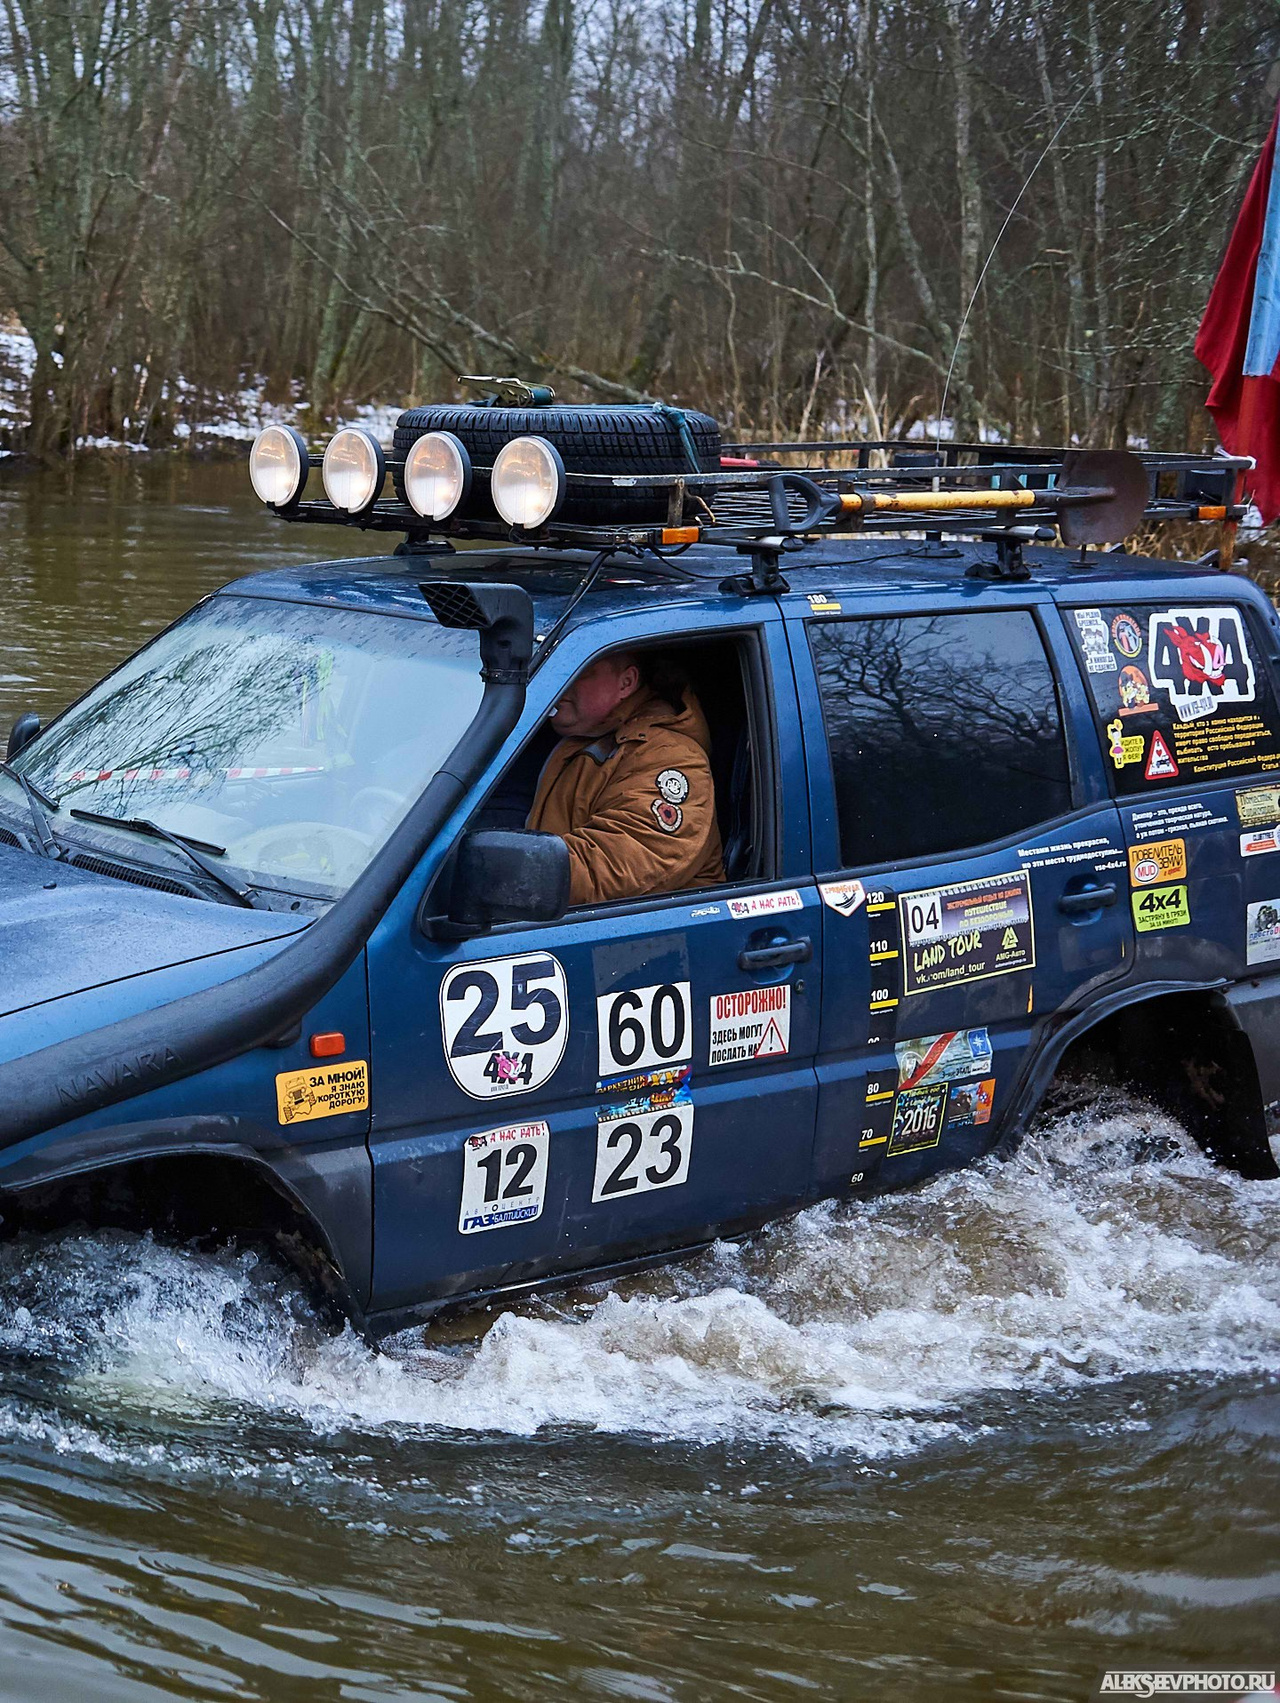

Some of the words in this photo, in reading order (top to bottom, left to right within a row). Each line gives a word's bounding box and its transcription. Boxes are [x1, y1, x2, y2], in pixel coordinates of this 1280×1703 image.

[807, 594, 827, 604] 180
[1018, 846, 1050, 857] Местами
[1073, 838, 1110, 849] прекрасна,
[1132, 844, 1183, 862] ПОВЕЛИТЕЛЬ
[1032, 860, 1045, 868] эти
[1045, 857, 1065, 866] места
[1137, 864, 1157, 878] MUD
[759, 898, 775, 910] НАС
[866, 891, 885, 903] 120
[1139, 888, 1182, 913] 4x4
[911, 901, 940, 934] 04
[1138, 913, 1166, 924] ЗАСТРЯНУ
[1170, 909, 1187, 918] ГРЯЗИ
[870, 940, 888, 952] 110
[913, 945, 946, 973] LAND
[947, 929, 983, 959] TOUR
[716, 986, 787, 1020] ОСТОРОЖНО!
[871, 989, 889, 1001] 100
[447, 960, 562, 1058] 25
[607, 984, 686, 1067] 60
[712, 1027, 738, 1045] ЗДЕСЬ
[739, 1023, 763, 1041] МОГУТ
[711, 1046, 747, 1064] ПОСЛАТЬ
[55, 1047, 182, 1106] NAVARA
[309, 1075, 325, 1088] ЗА
[327, 1066, 366, 1085] МНОЙ!
[316, 1088, 366, 1103] КОРОТКУЮ
[331, 1084, 339, 1093] Я
[339, 1080, 366, 1092] ЗНАЮ
[867, 1082, 880, 1094] 80
[328, 1095, 366, 1110] ДОРОГУ!
[901, 1104, 939, 1136] 2016
[490, 1132, 496, 1143] А
[500, 1129, 517, 1142] НАС
[520, 1123, 545, 1138] РАТЬ!
[861, 1128, 874, 1140] 70
[599, 1114, 683, 1198] 23
[477, 1144, 538, 1203] 12
[851, 1172, 864, 1184] 60
[463, 1215, 493, 1231] ГАЗ
[494, 1204, 539, 1224] БАЛТИЙСКИЙ
